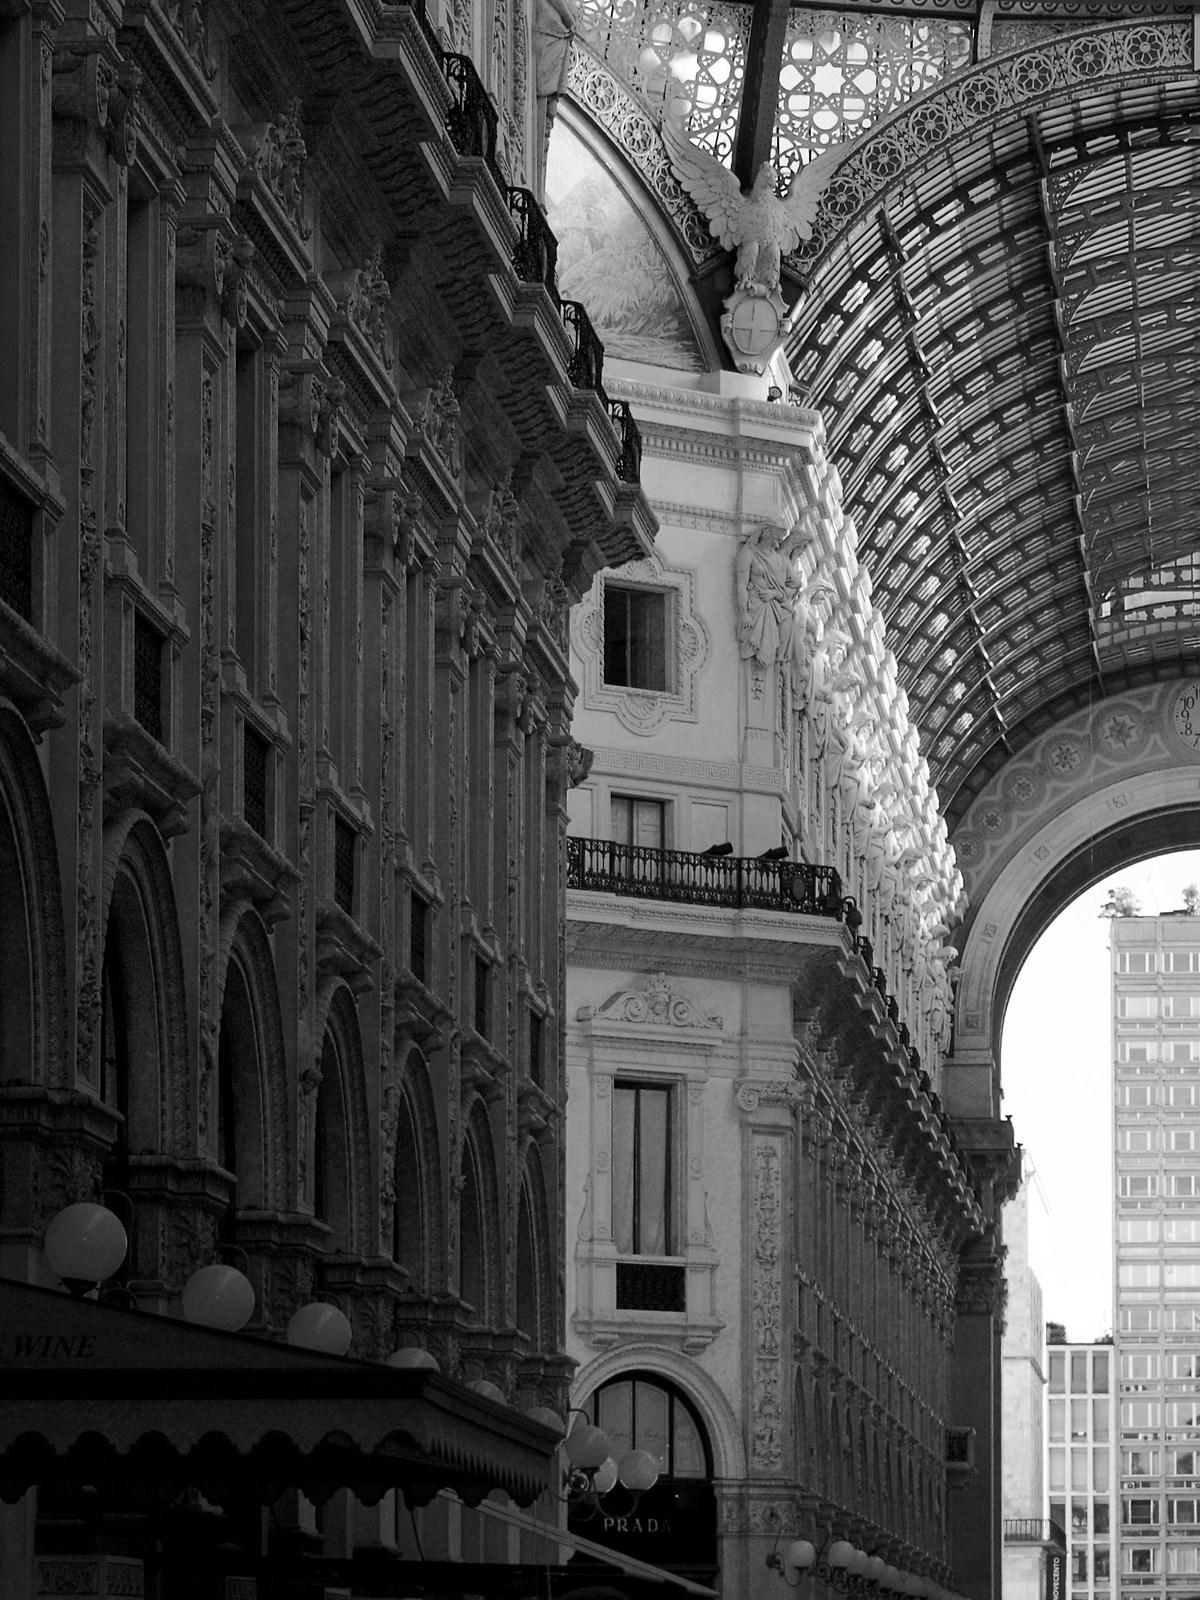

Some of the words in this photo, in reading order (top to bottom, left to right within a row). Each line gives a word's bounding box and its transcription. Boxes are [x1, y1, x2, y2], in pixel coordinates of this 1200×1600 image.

[1183, 696, 1195, 710] 10
[1180, 709, 1190, 723] 9
[1184, 722, 1193, 736] 8
[1194, 733, 1200, 745] 7
[14, 1335, 97, 1358] WINE
[603, 1517, 672, 1533] PRADA
